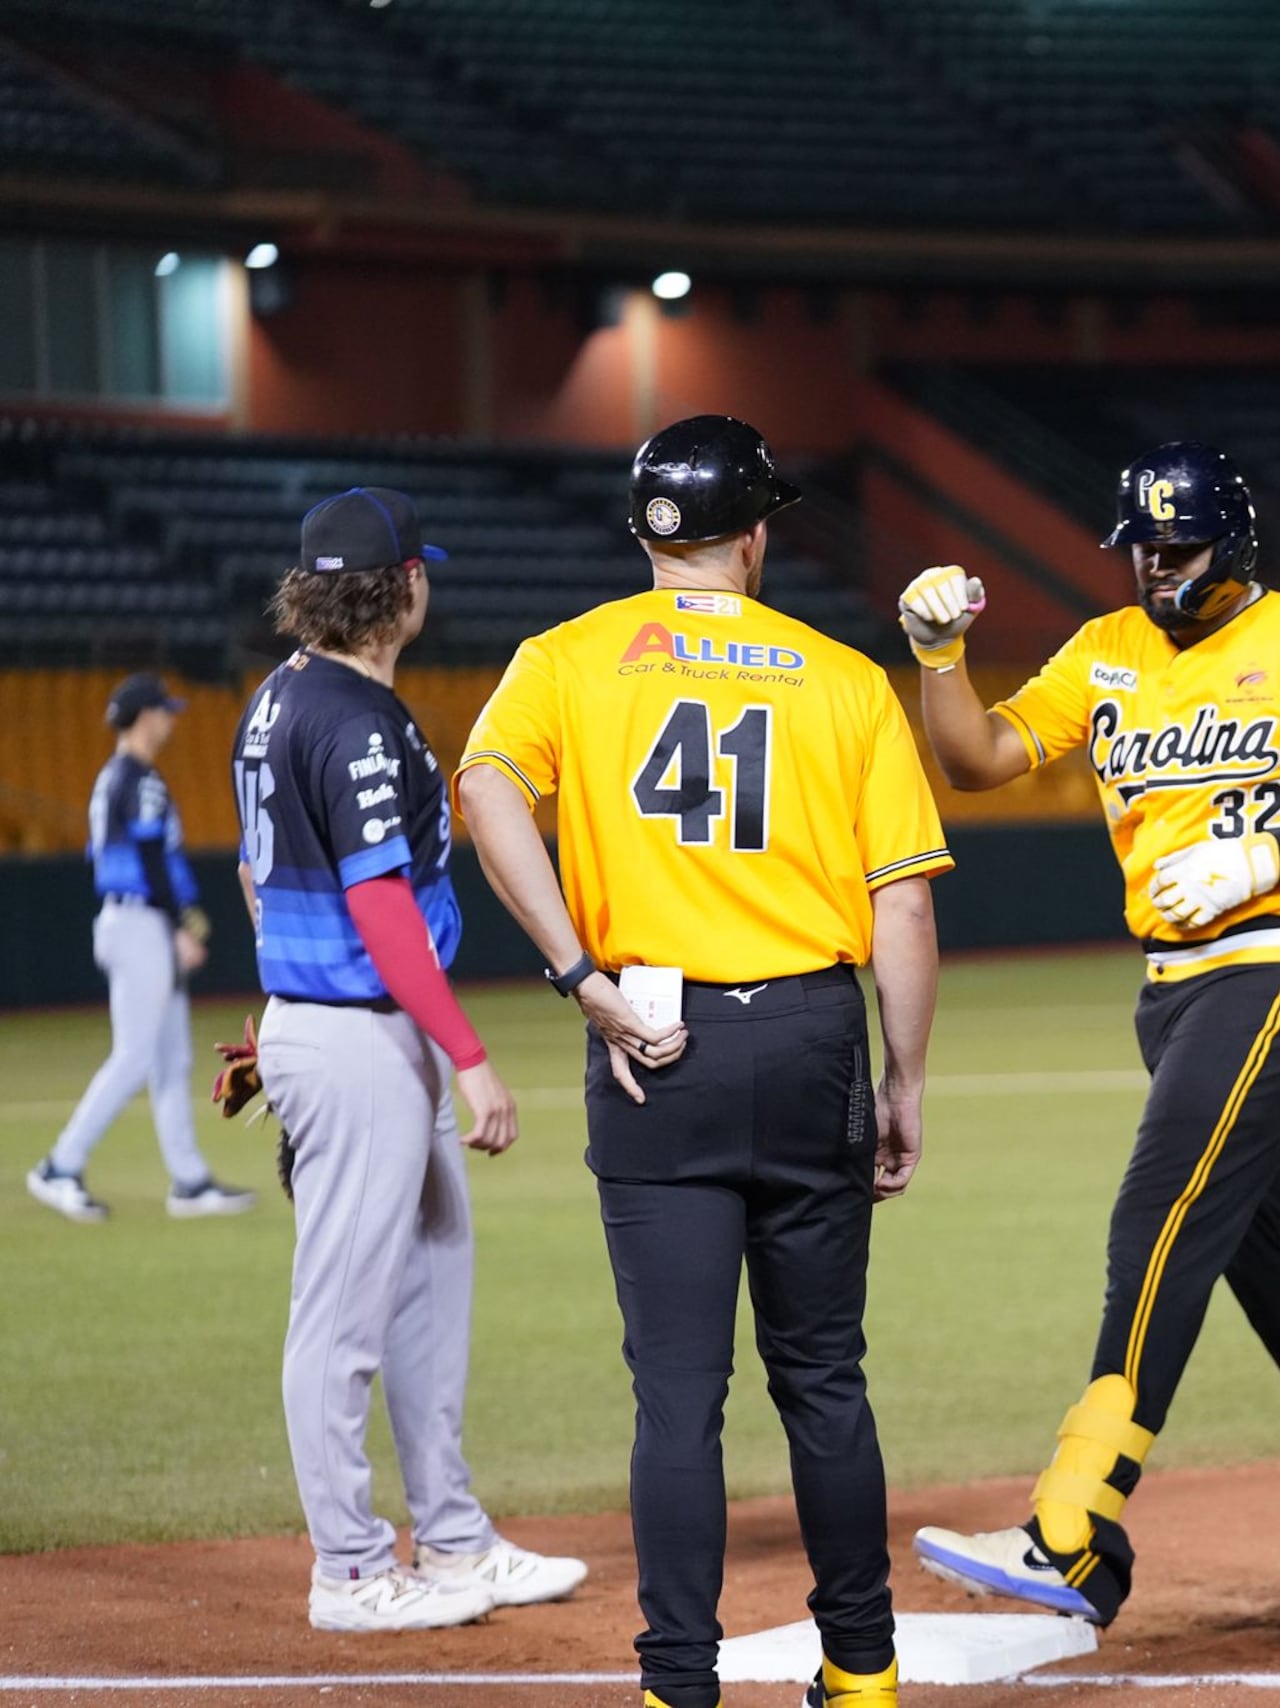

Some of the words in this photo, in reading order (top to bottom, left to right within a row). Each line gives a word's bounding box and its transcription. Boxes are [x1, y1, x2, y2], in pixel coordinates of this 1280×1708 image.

[717, 598, 740, 614] 21
[619, 622, 806, 670] ALLIED
[618, 663, 655, 677] Car
[662, 662, 677, 674] &
[680, 665, 730, 681] Truck
[736, 671, 805, 688] Rental
[1089, 700, 1280, 786] Carolina
[630, 698, 773, 853] 41
